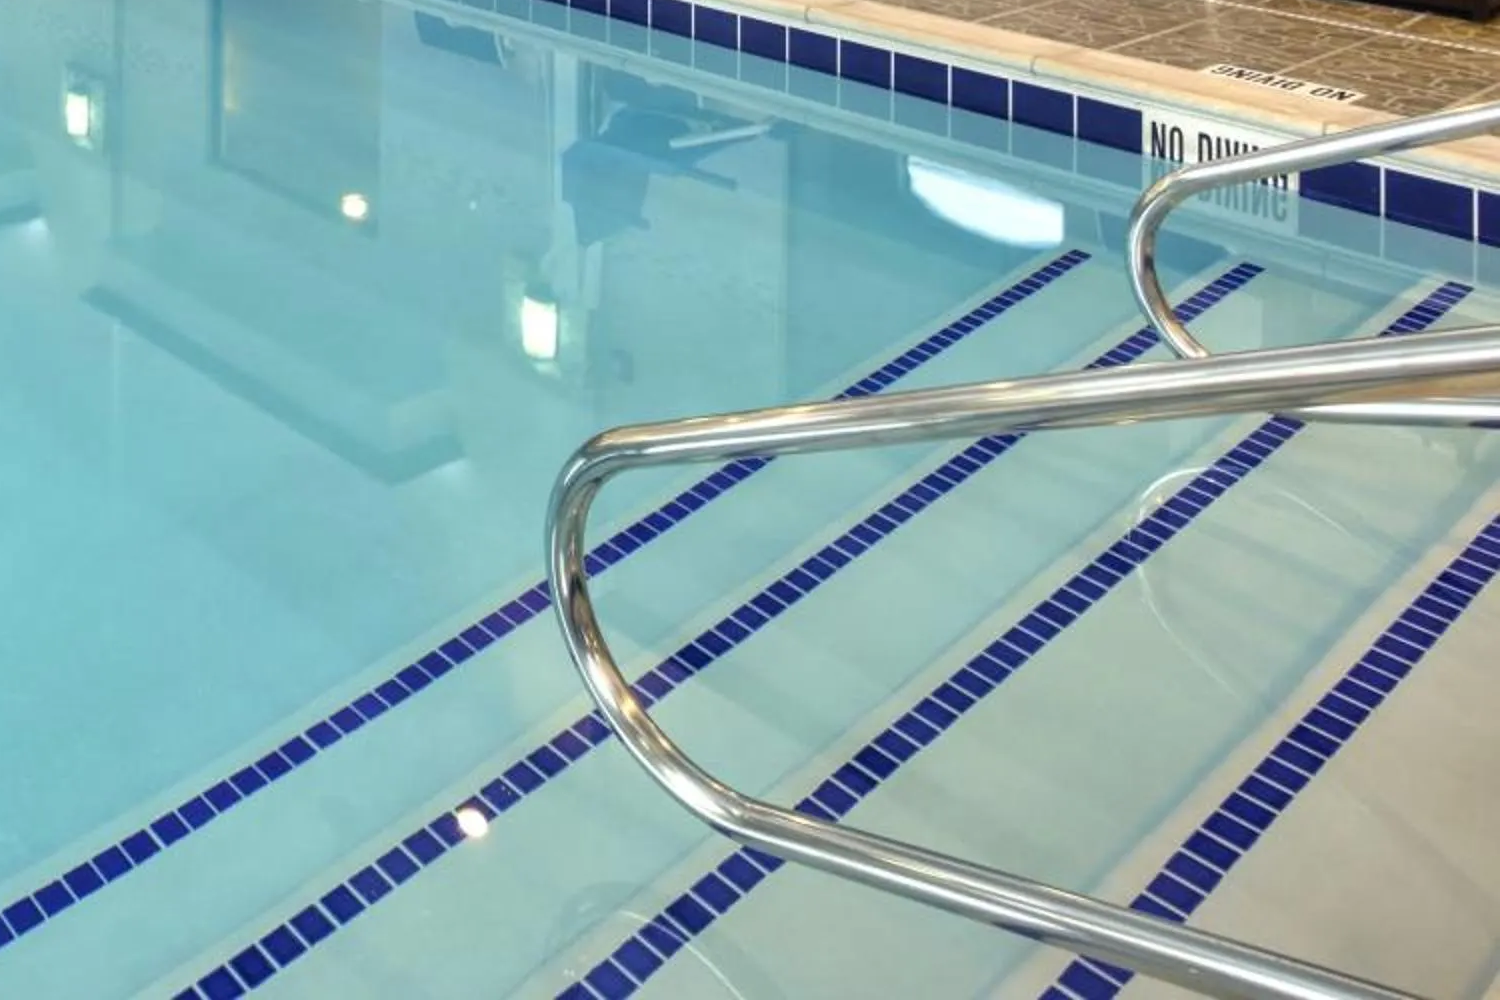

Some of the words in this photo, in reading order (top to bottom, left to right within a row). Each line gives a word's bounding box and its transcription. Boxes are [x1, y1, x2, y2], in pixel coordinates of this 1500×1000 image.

[1211, 65, 1306, 91] DIVING
[1309, 86, 1357, 102] NO
[1150, 121, 1184, 164] NO
